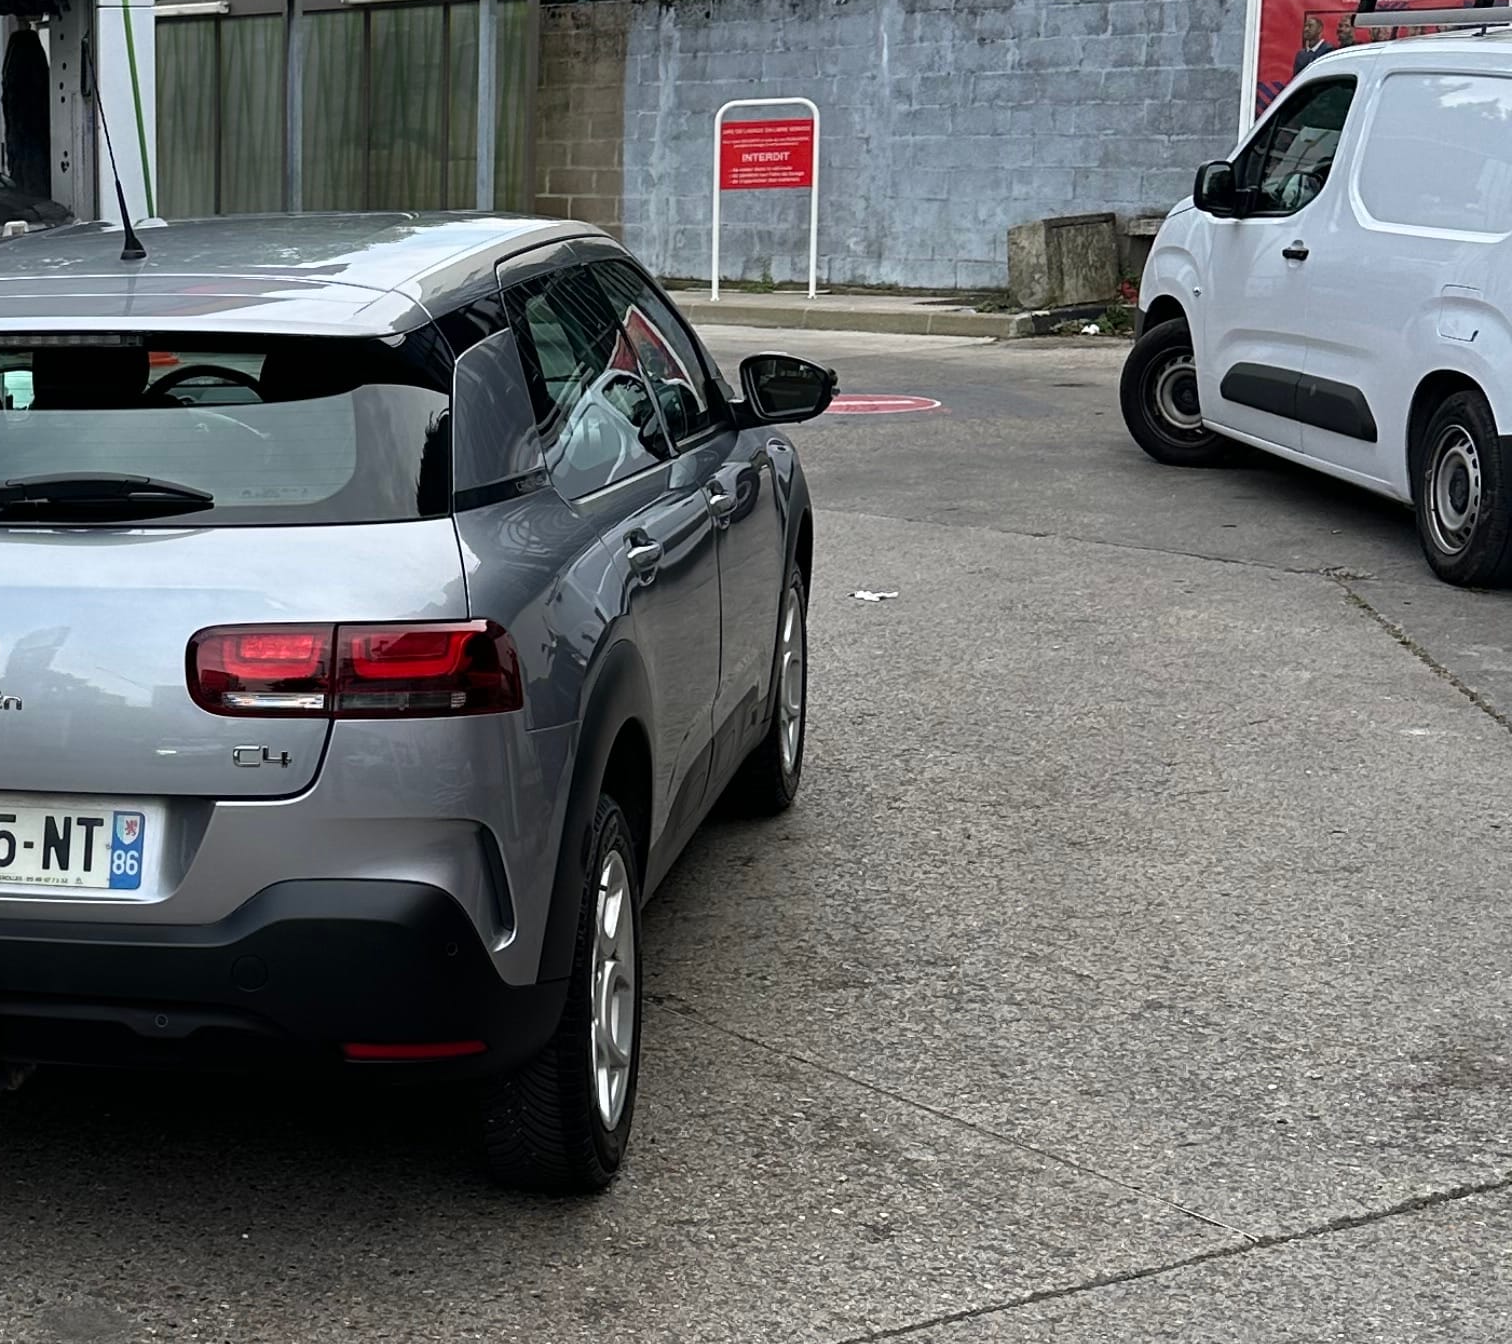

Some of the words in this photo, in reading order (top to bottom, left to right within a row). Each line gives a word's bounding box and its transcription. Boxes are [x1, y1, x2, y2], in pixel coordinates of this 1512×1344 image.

[741, 151, 790, 163] INTERDIT
[232, 744, 293, 768] C4
[112, 849, 140, 876] 86
